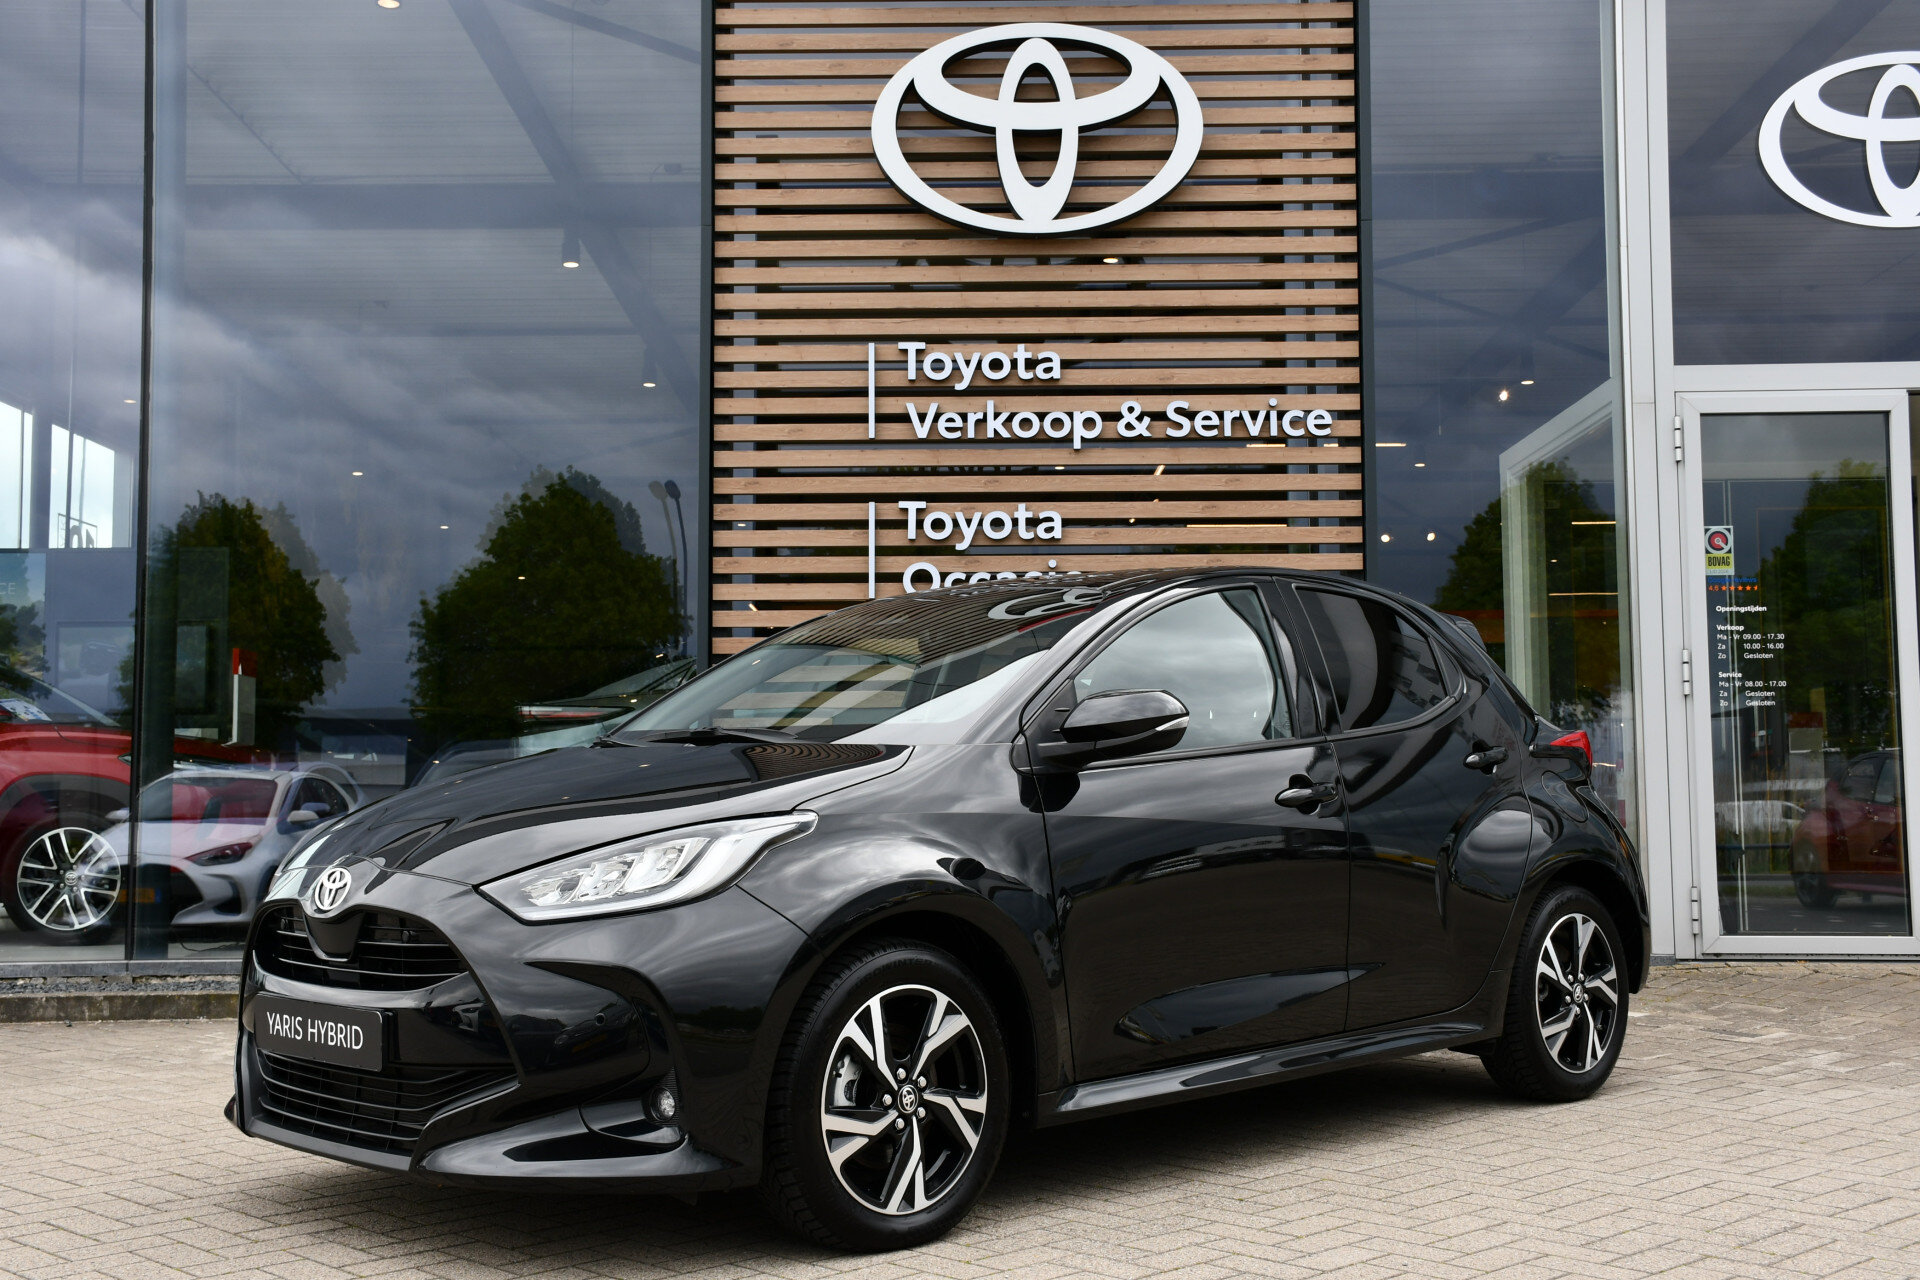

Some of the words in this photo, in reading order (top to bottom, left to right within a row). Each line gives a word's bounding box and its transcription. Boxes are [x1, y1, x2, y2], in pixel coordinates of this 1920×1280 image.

[898, 342, 1061, 391] Toyota
[906, 400, 1103, 450] Verkoop
[1116, 400, 1153, 438] &
[1166, 398, 1334, 438] Service
[898, 501, 1063, 552] Toyota
[1708, 556, 1730, 566] BOVAG
[1715, 605, 1767, 613] Openingstijden
[267, 1012, 303, 1041] YARIS
[307, 1018, 364, 1049] HYBRID
